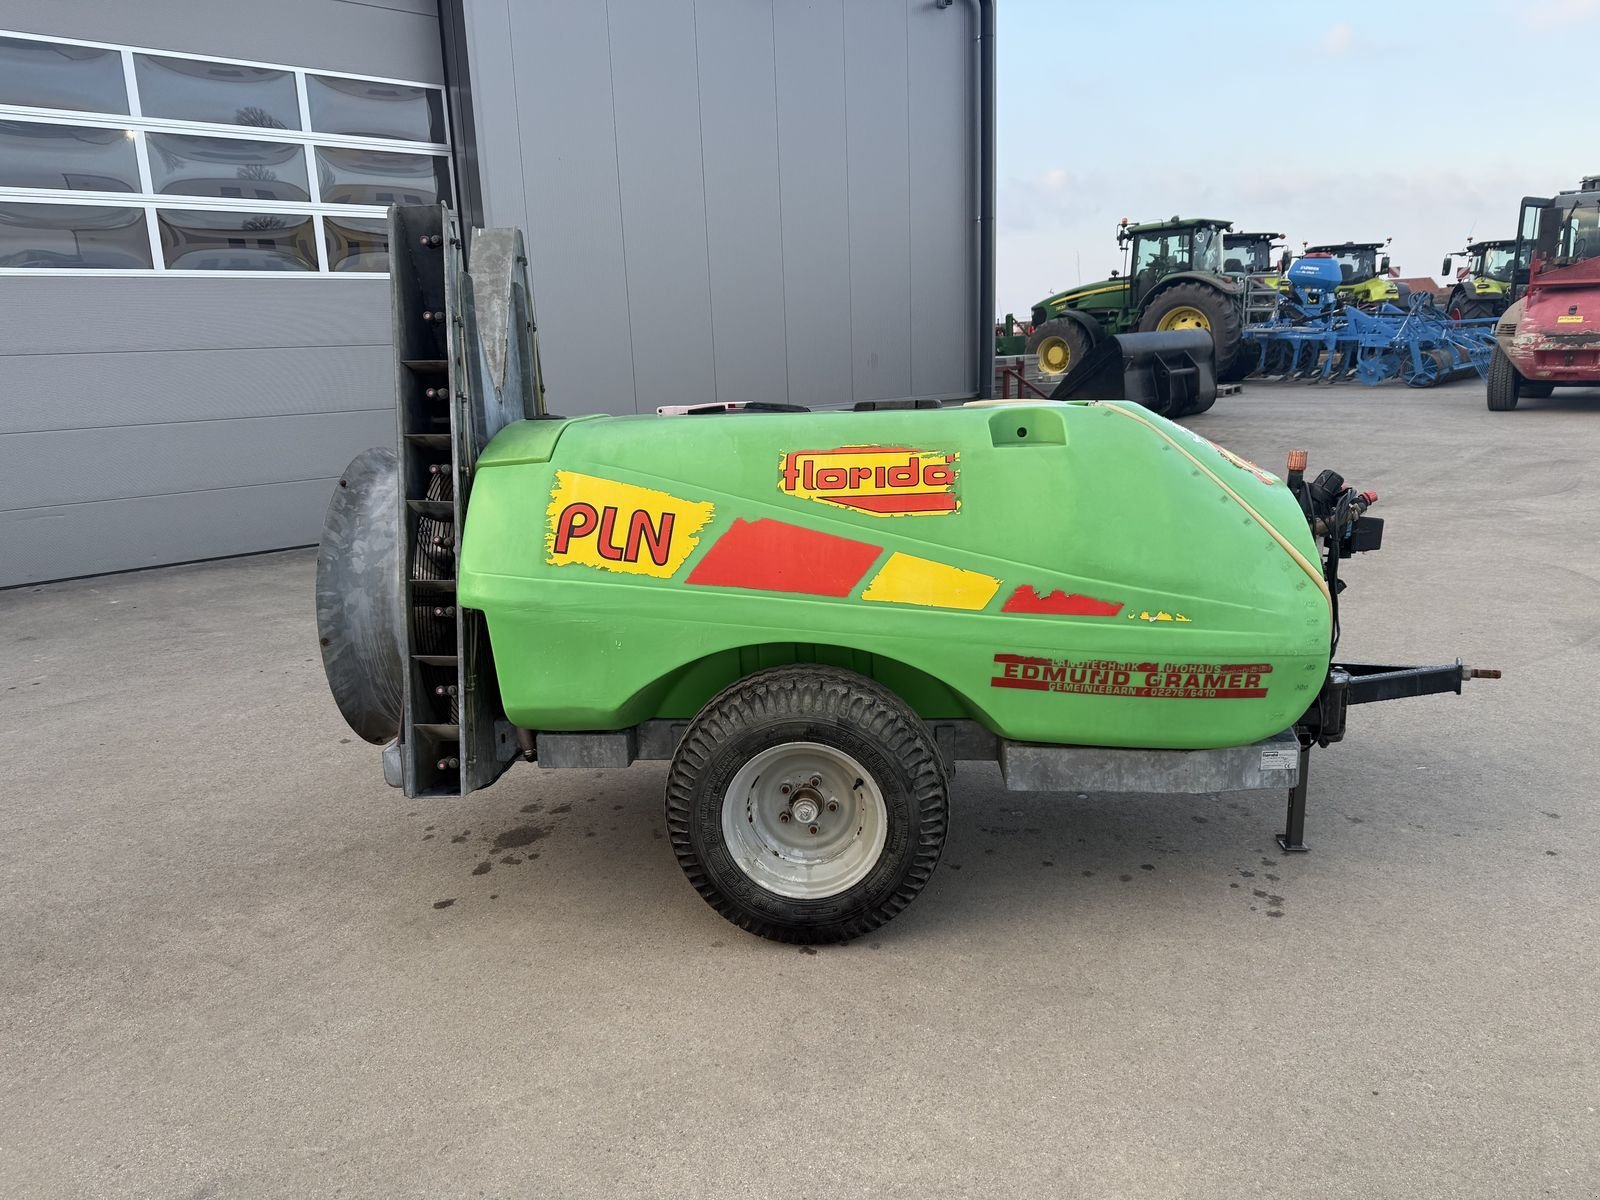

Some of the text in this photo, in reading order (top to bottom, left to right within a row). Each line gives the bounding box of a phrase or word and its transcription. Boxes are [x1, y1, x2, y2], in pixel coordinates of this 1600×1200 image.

[783, 453, 955, 491] florida
[553, 502, 676, 566] PLN
[1004, 663, 1261, 689] EDMUND GRAMER
[1049, 682, 1137, 696] GEMEINLEBARN
